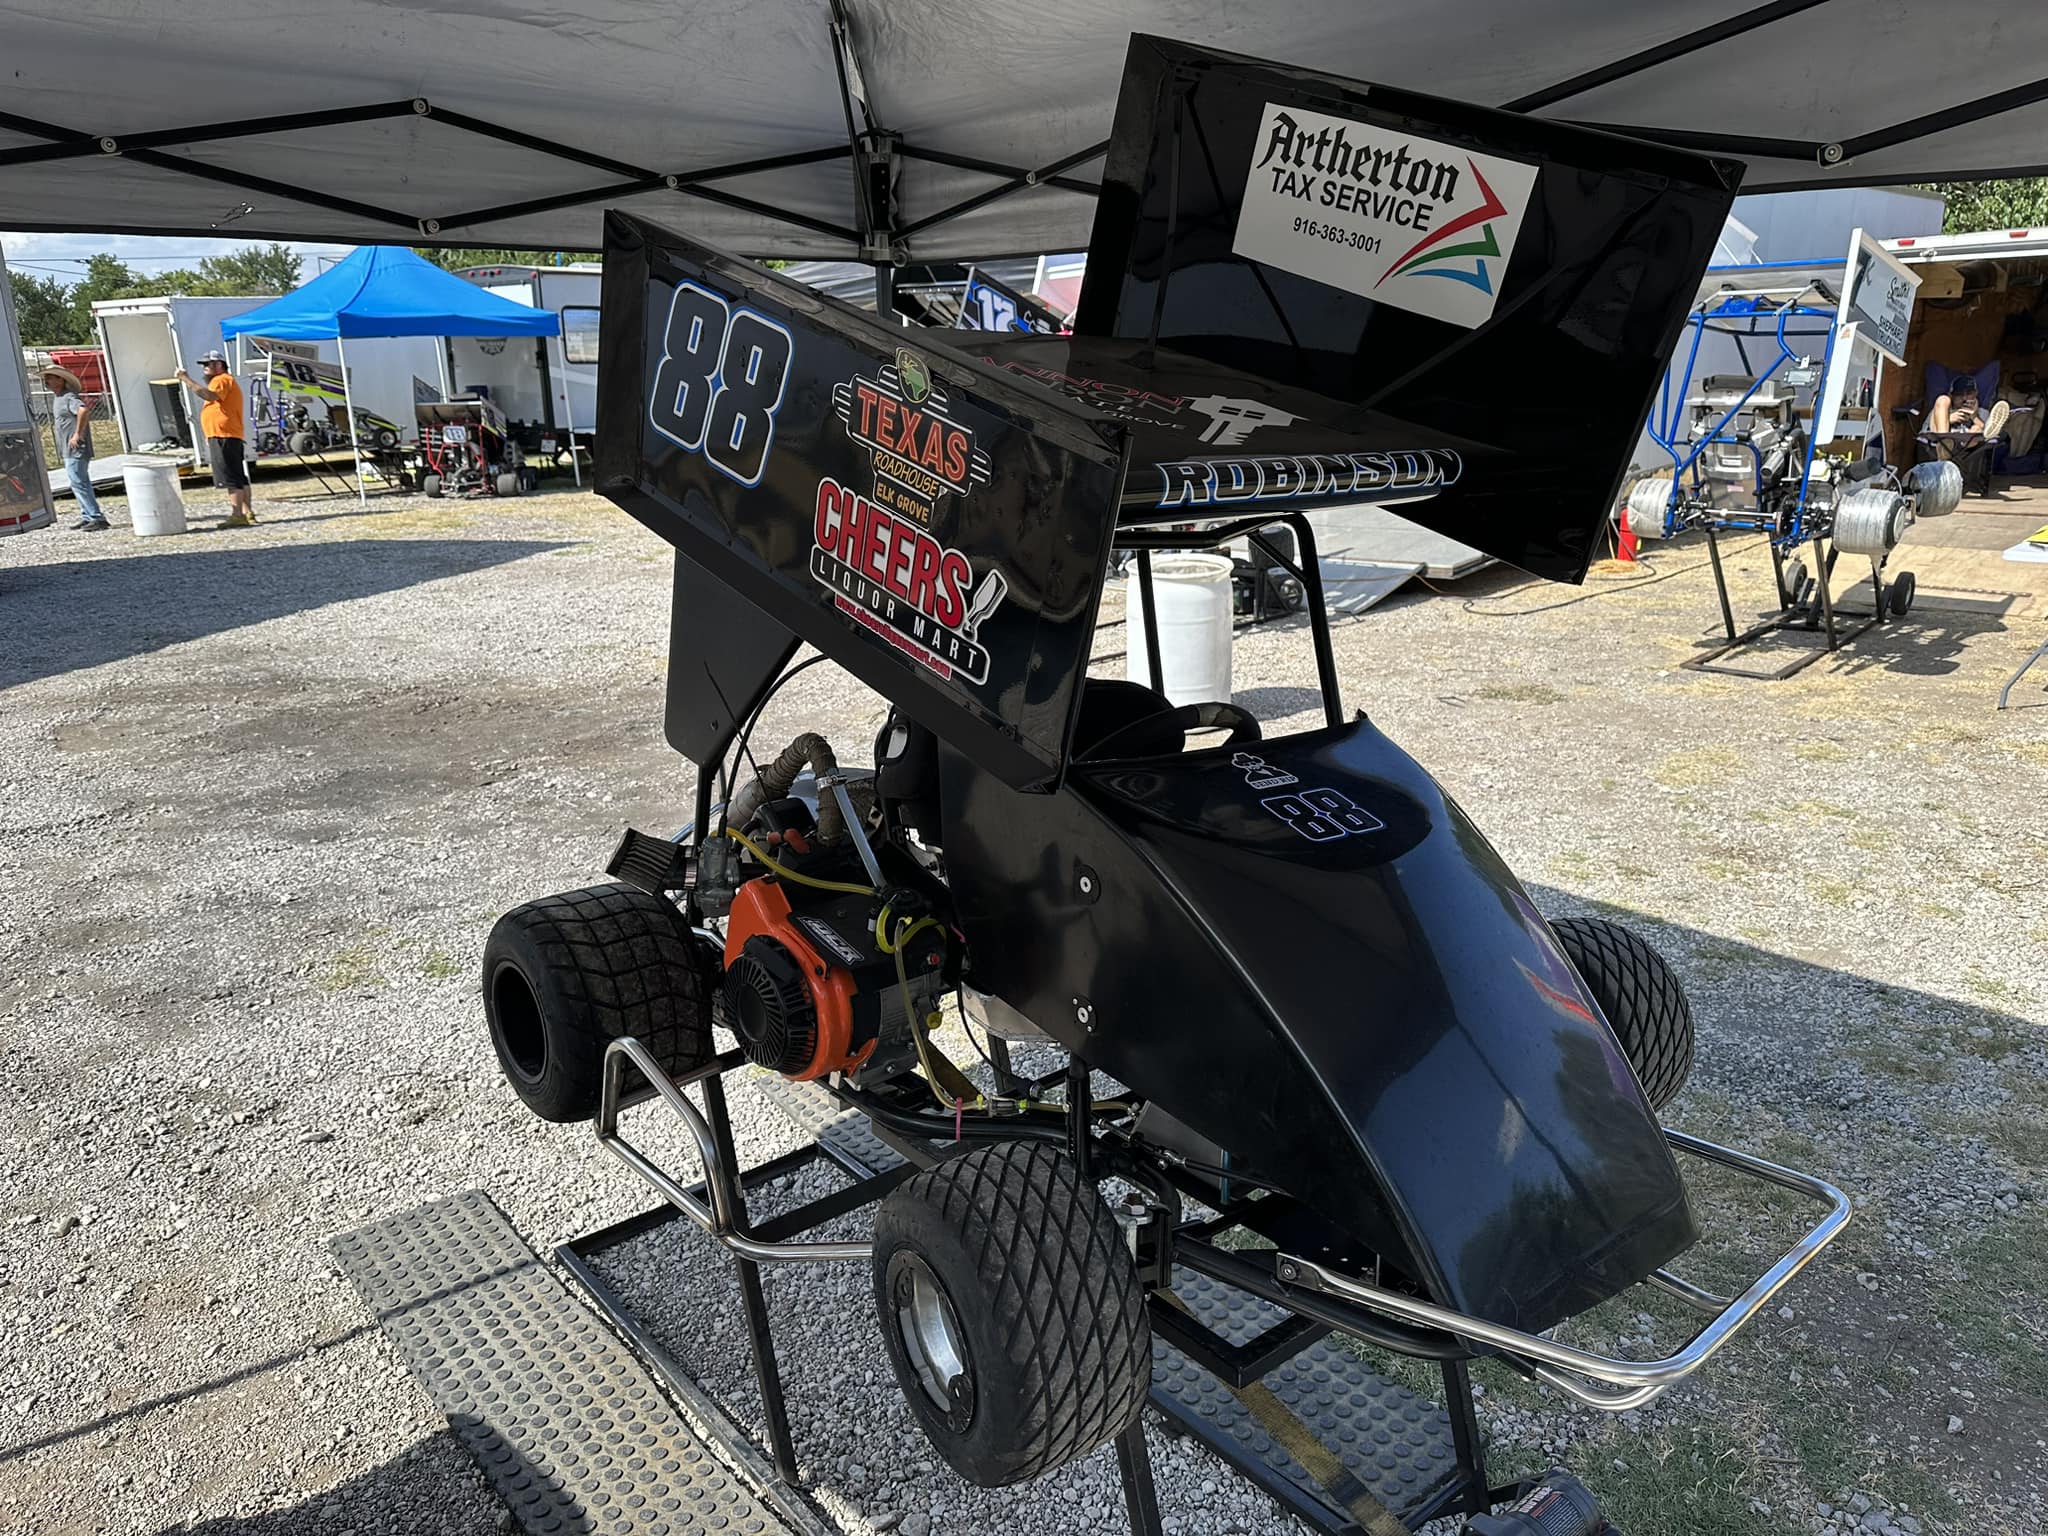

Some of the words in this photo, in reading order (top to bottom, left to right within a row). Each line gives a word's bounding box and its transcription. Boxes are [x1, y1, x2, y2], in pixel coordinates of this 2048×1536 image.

[1256, 111, 1460, 204] Artherton
[1270, 166, 1317, 202] TAX
[1320, 180, 1434, 232] SERVICE
[1293, 216, 1383, 255] 916-363-3001
[974, 284, 1018, 332] 17
[649, 278, 794, 489] 88
[857, 385, 969, 484] TEXAS
[873, 450, 940, 497] ROADHOUSE
[876, 482, 895, 504] ELK
[896, 493, 930, 524] GROVE
[1155, 448, 1463, 508] ROBINSON
[816, 482, 971, 628] CHEERS
[818, 554, 897, 621] LIQUOR
[913, 615, 977, 669] MART
[1260, 787, 1385, 843] 88
